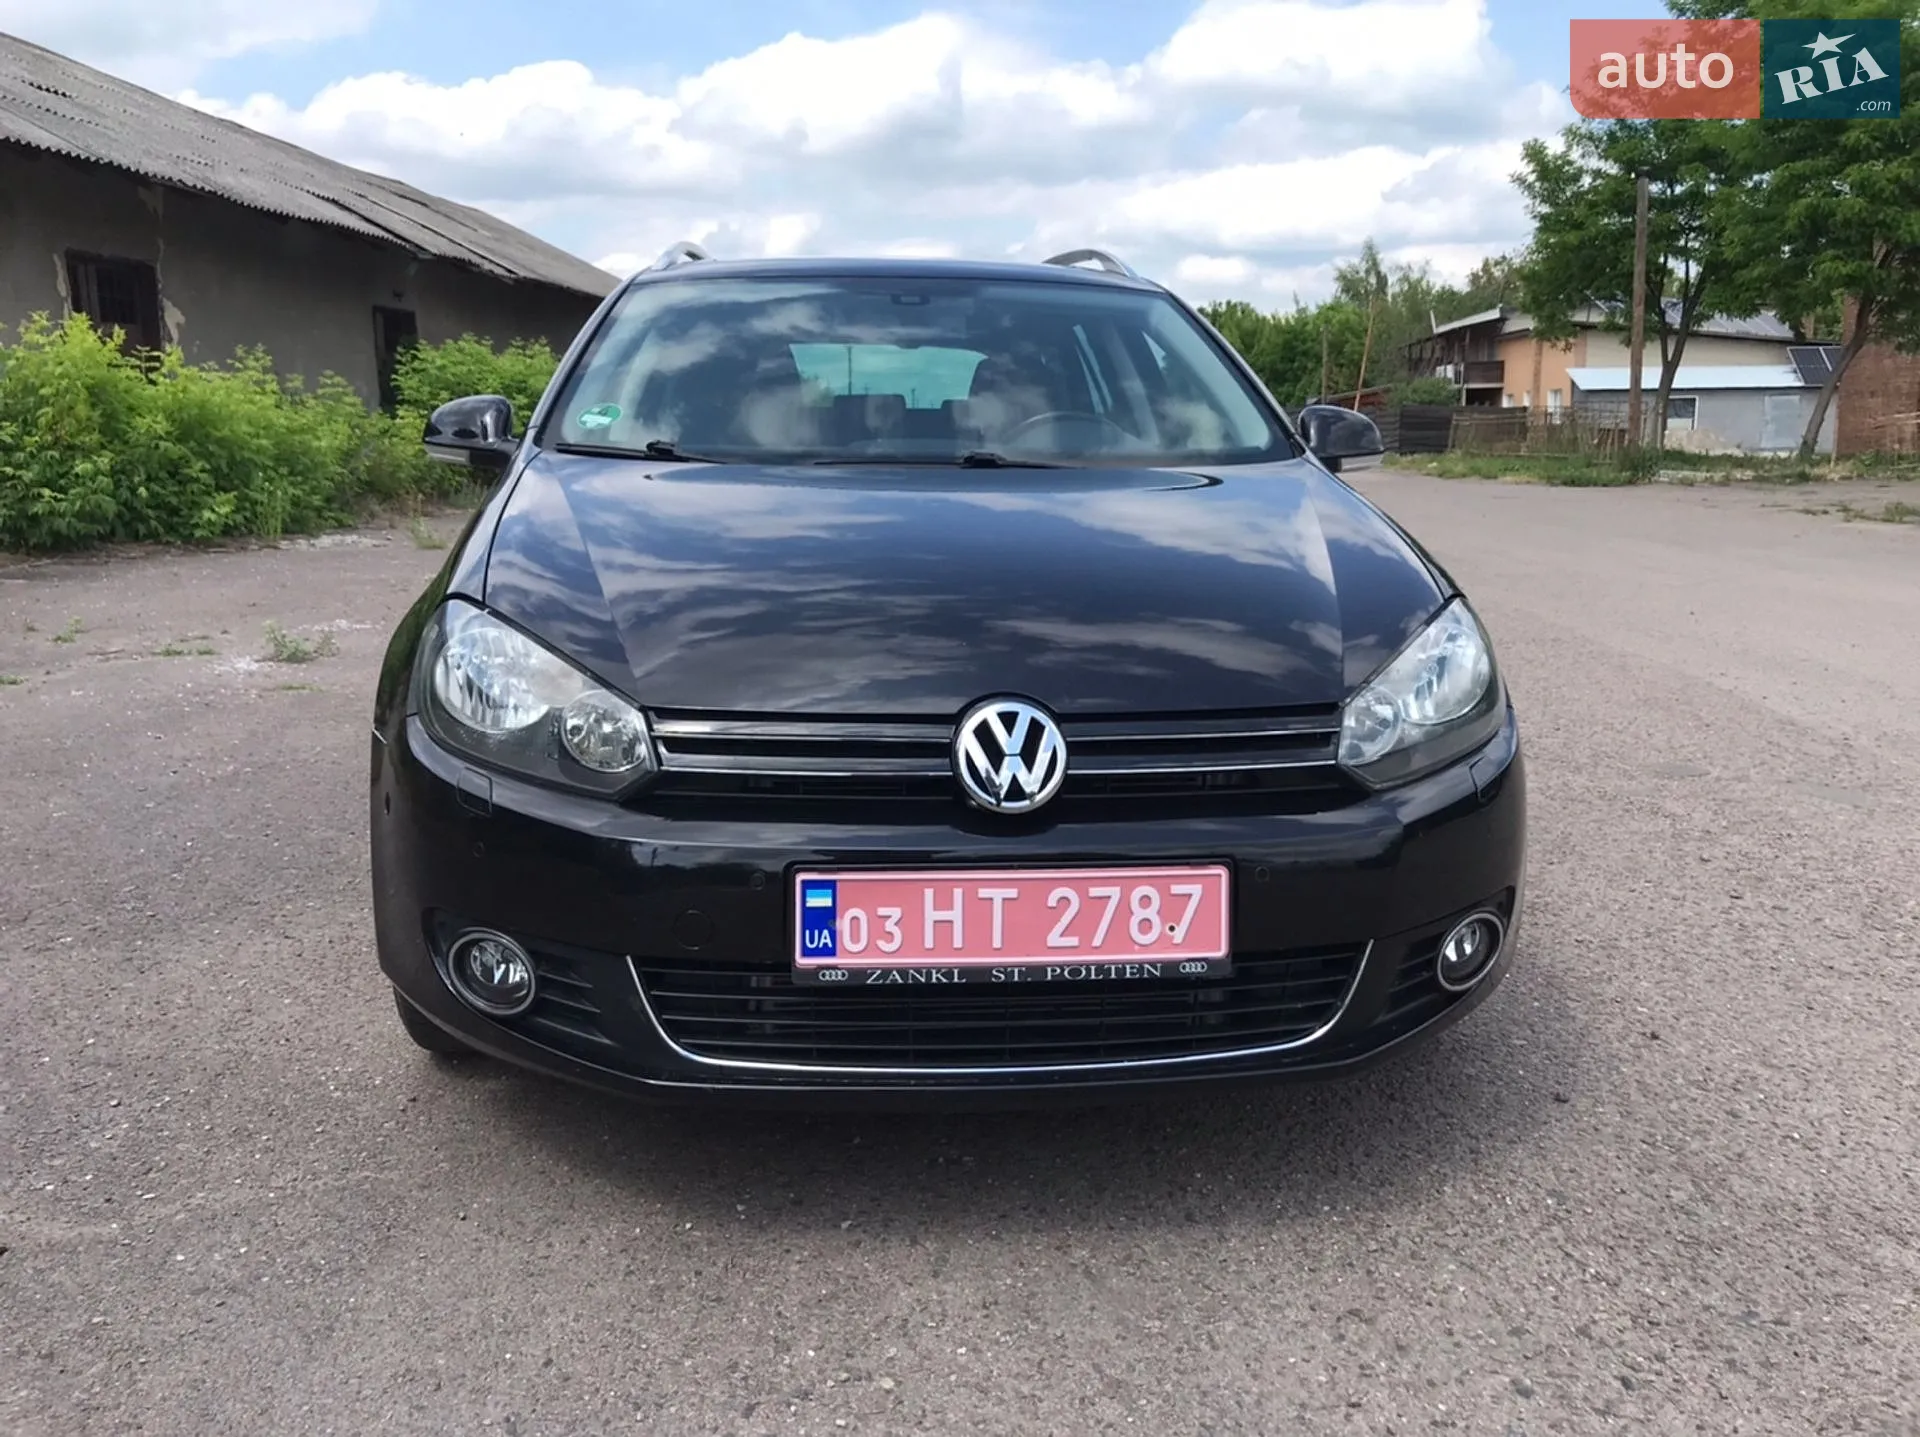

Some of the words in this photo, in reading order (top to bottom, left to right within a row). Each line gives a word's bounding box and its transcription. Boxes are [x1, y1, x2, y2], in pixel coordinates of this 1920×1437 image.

[841, 906, 903, 954] 03
[923, 886, 1019, 950] HT
[1045, 883, 1203, 949] 2787
[805, 929, 833, 949] UA
[866, 967, 967, 985] ZANKL
[991, 967, 1031, 982] ST.
